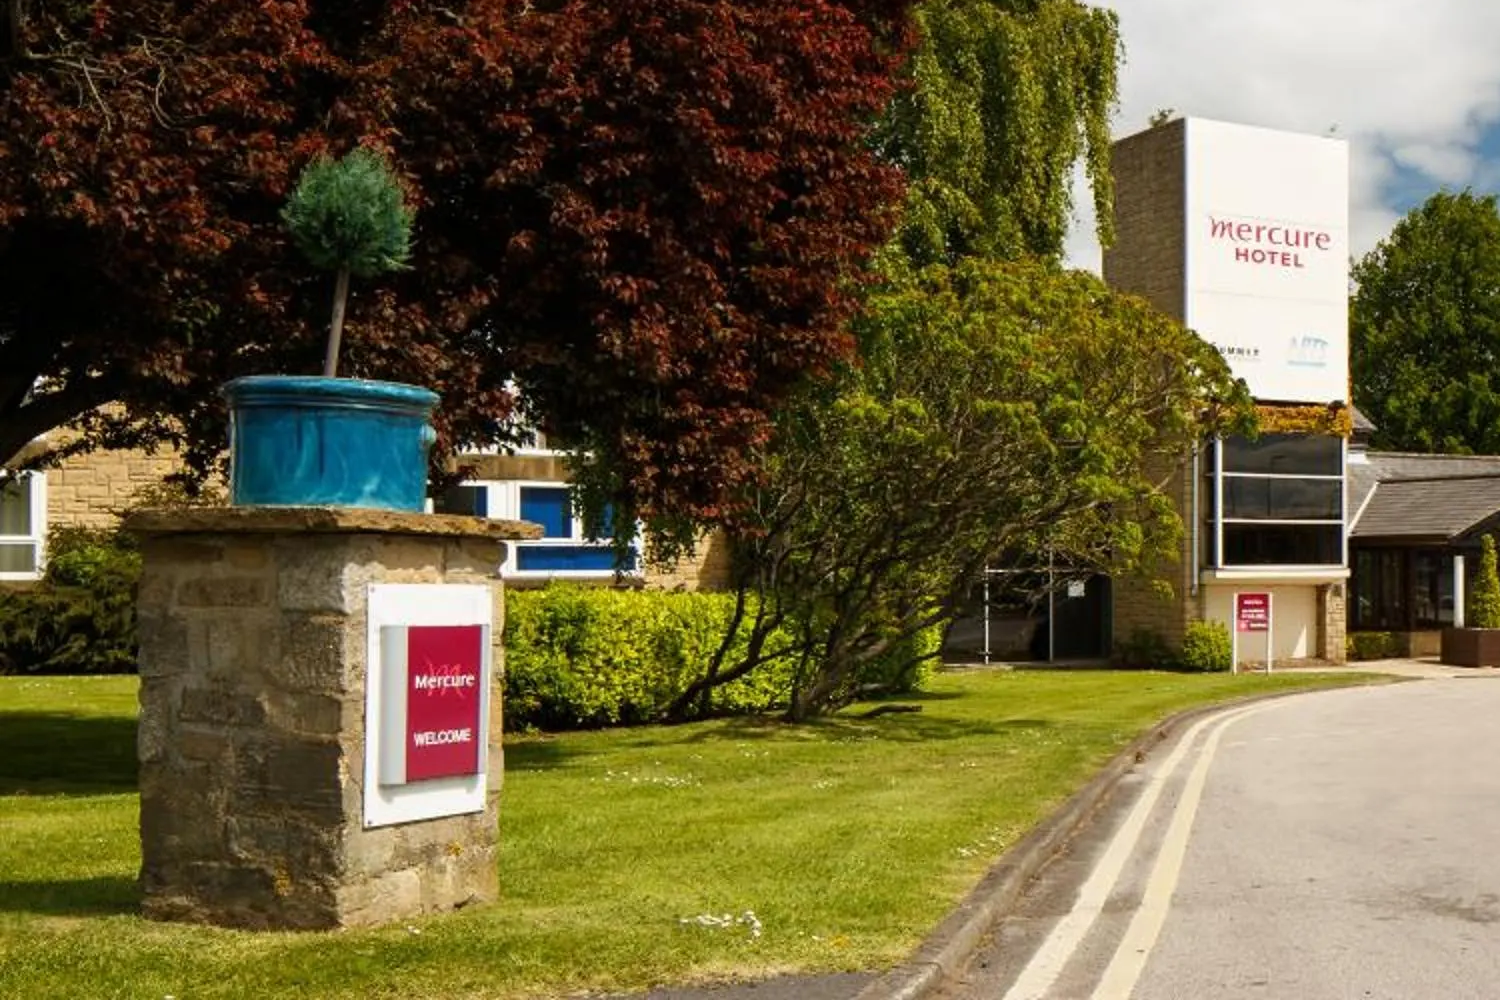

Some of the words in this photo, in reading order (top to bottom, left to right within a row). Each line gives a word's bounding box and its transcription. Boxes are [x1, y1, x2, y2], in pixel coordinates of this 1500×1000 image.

[1209, 216, 1331, 251] mercure
[1235, 247, 1304, 268] HOTEL
[415, 673, 475, 689] Mercure
[413, 728, 472, 747] WELCOME
